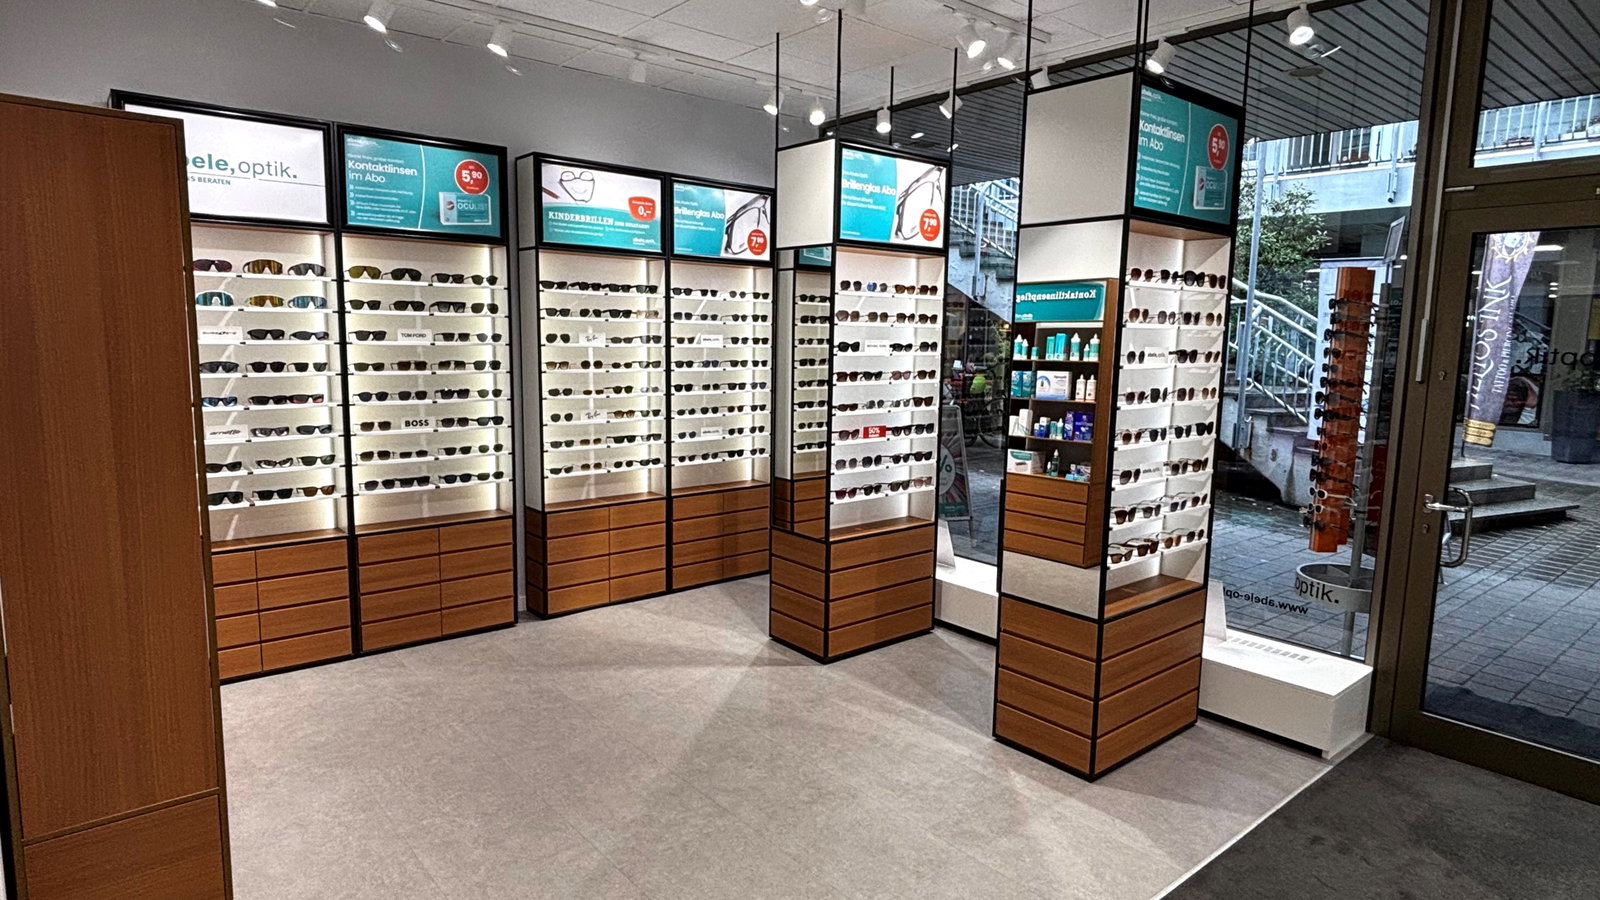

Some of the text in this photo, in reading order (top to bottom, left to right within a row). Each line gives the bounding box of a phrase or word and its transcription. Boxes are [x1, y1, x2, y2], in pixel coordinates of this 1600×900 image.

[1139, 120, 1185, 143] Kontaktlinsen
[1149, 137, 1163, 151] Abo
[186, 153, 235, 175] ele,
[348, 160, 418, 176] Kontaktlinsen
[197, 176, 231, 185] BERATEN
[348, 170, 386, 183] im Abo
[461, 169, 483, 185] 5,90
[882, 185, 896, 196] Abo
[548, 211, 614, 226] KINDERBRILLEN
[711, 210, 725, 220] Abo
[1482, 275, 1512, 321] INK
